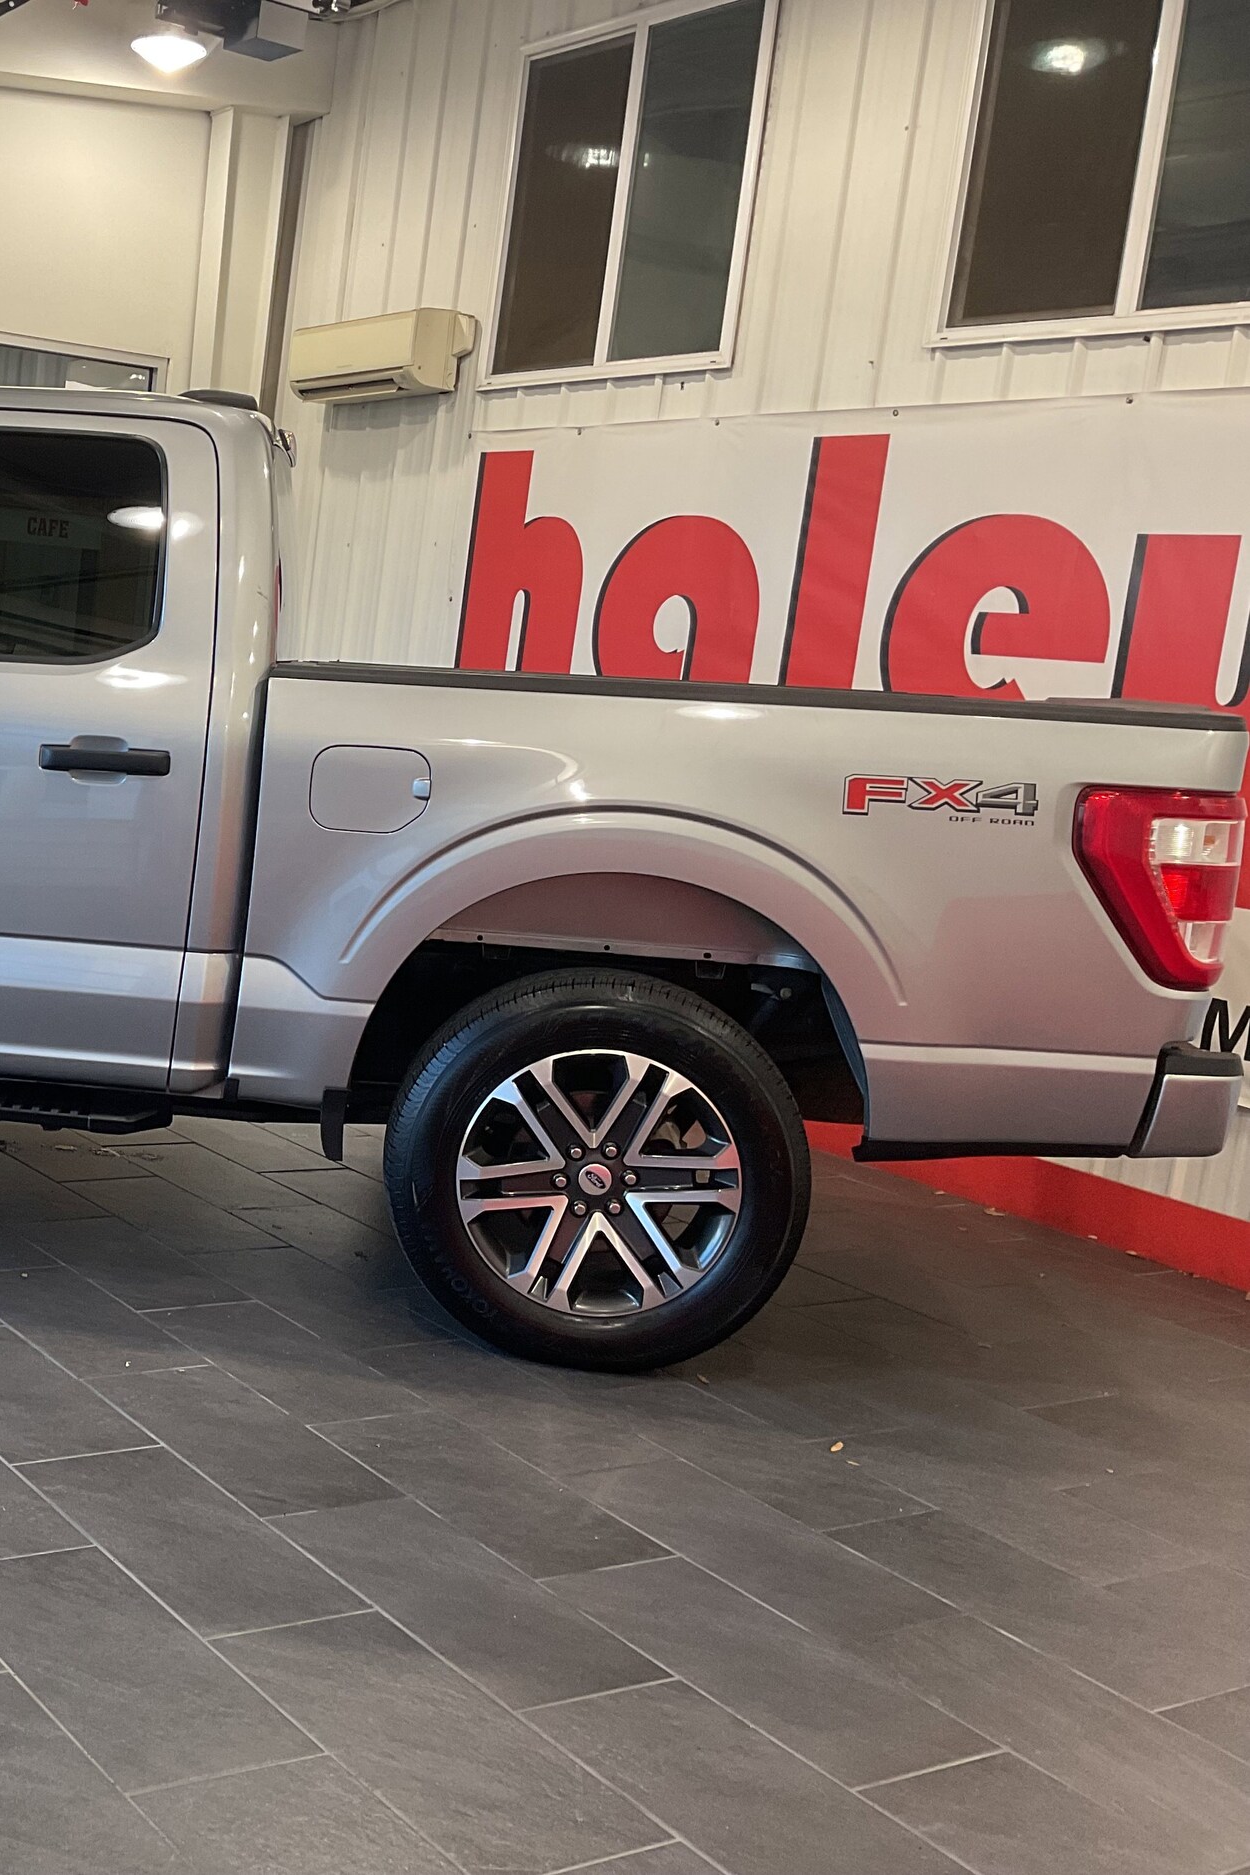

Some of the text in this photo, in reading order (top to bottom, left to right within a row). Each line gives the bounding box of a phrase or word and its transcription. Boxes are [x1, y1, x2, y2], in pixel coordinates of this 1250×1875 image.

[27, 517, 70, 538] CAFE
[842, 774, 1039, 817] FX4
[949, 815, 1035, 826] OFF ROAD
